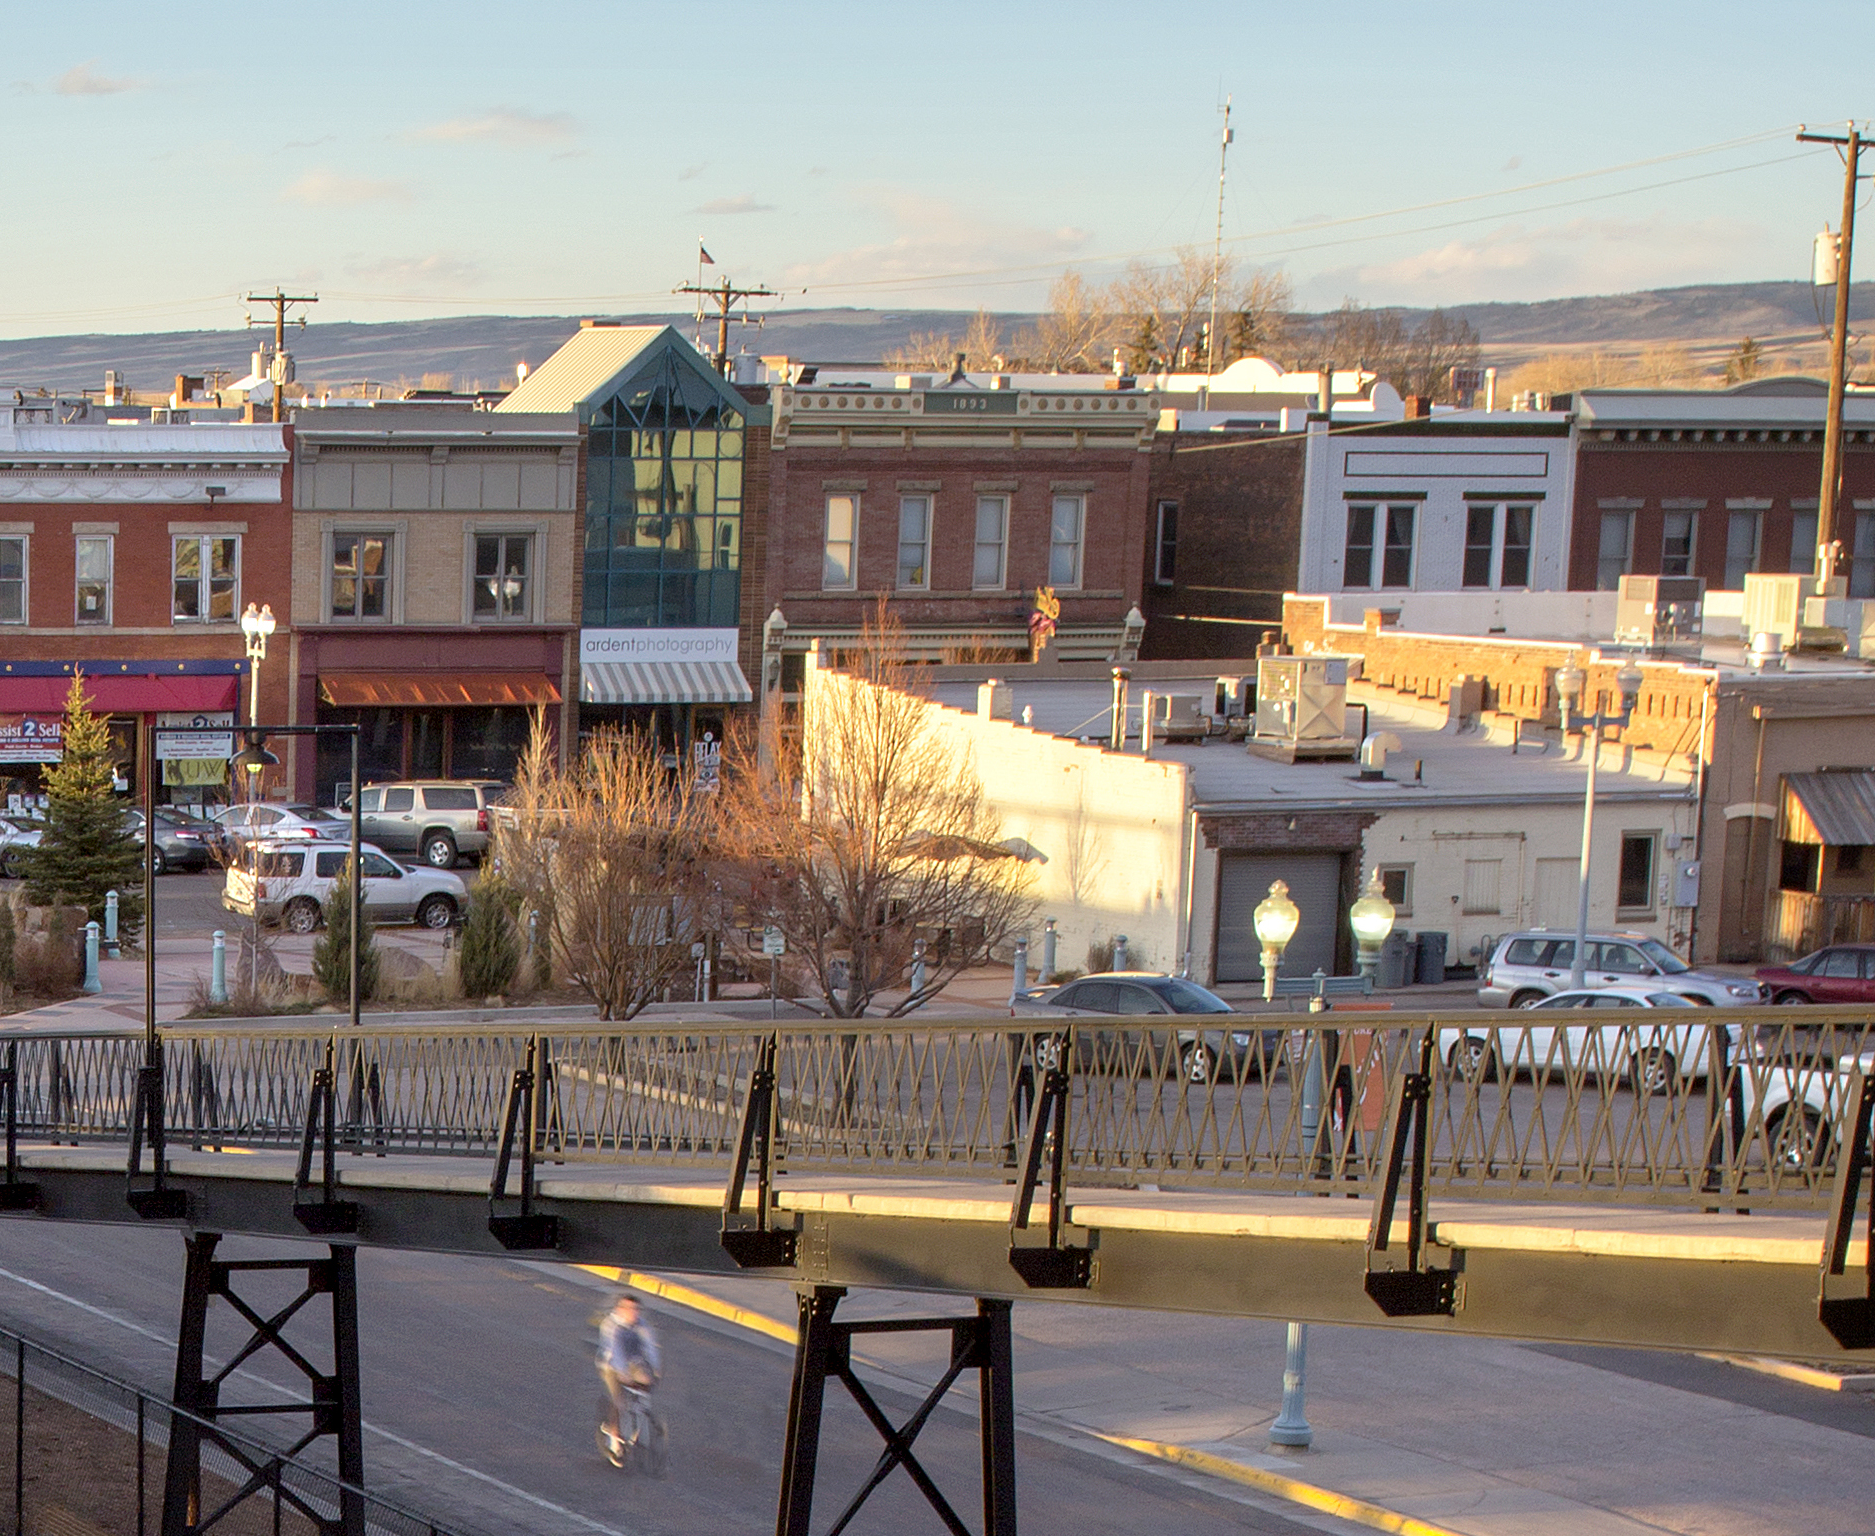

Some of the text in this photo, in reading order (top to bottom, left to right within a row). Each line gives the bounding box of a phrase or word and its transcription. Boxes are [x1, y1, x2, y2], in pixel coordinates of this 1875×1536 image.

[953, 398, 987, 410] 1893
[25, 721, 35, 737] 2
[39, 723, 61, 737] Sell
[186, 759, 225, 779] UW
